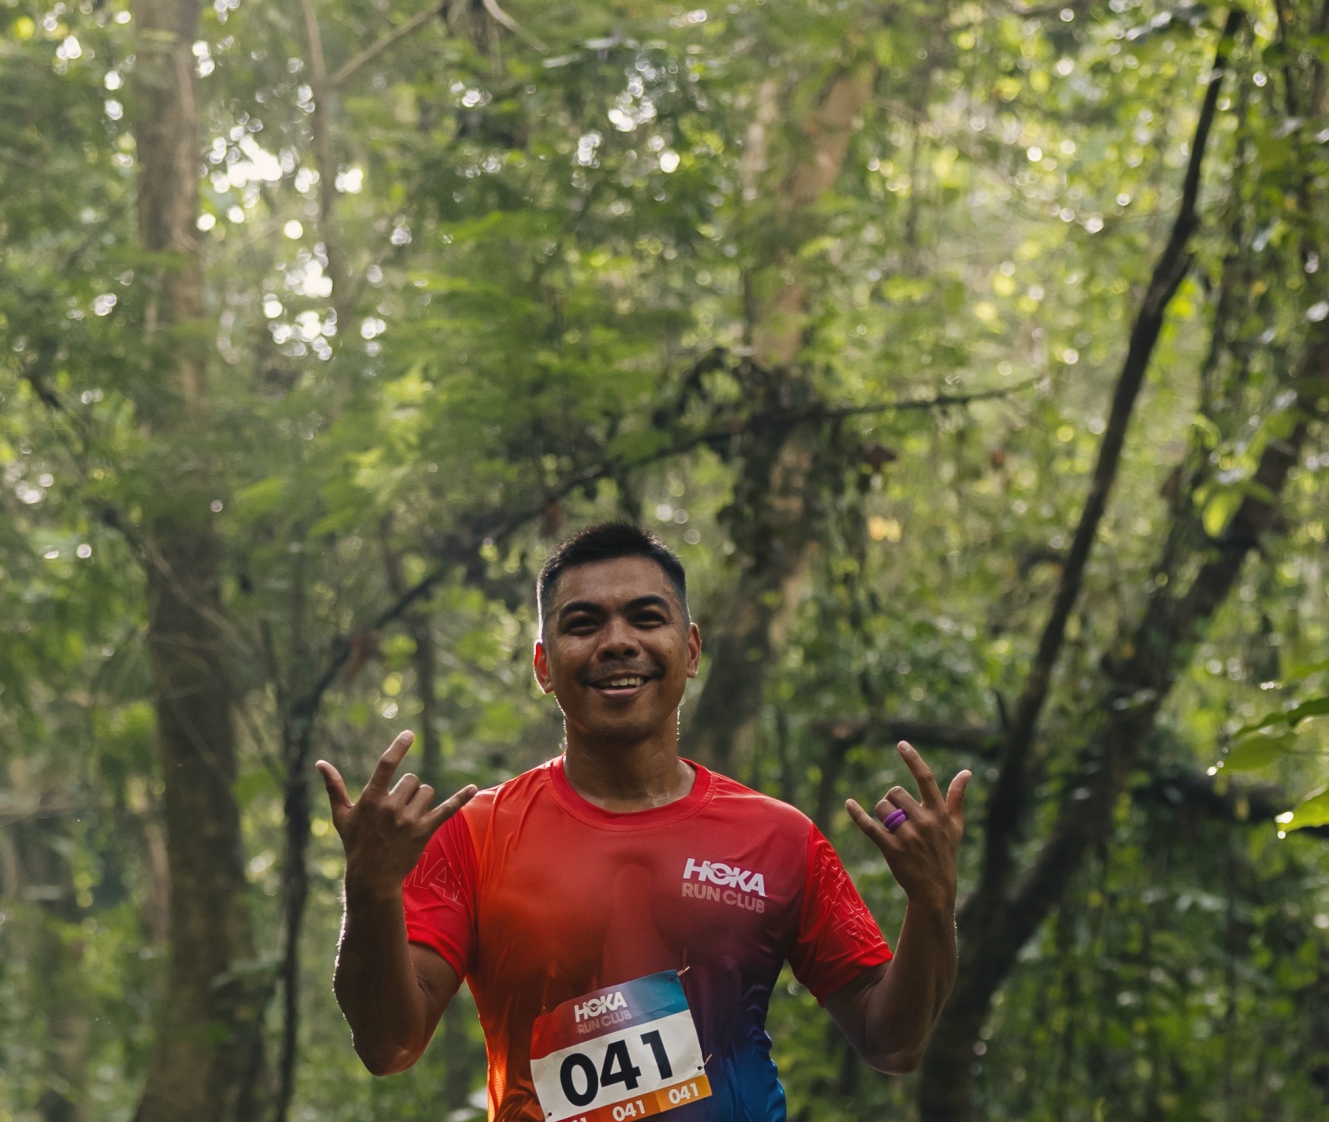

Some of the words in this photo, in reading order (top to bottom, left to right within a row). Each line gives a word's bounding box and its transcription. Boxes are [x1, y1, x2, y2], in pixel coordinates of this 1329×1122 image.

[683, 858, 766, 897] HOKA
[682, 882, 721, 902] RUN
[722, 890, 765, 914] CLUB
[574, 991, 627, 1023] HOKA
[576, 1021, 600, 1035] RUN
[601, 1010, 632, 1027] CLUB
[560, 1029, 673, 1107] 041
[612, 1100, 645, 1122] 041
[668, 1082, 699, 1105] 041
